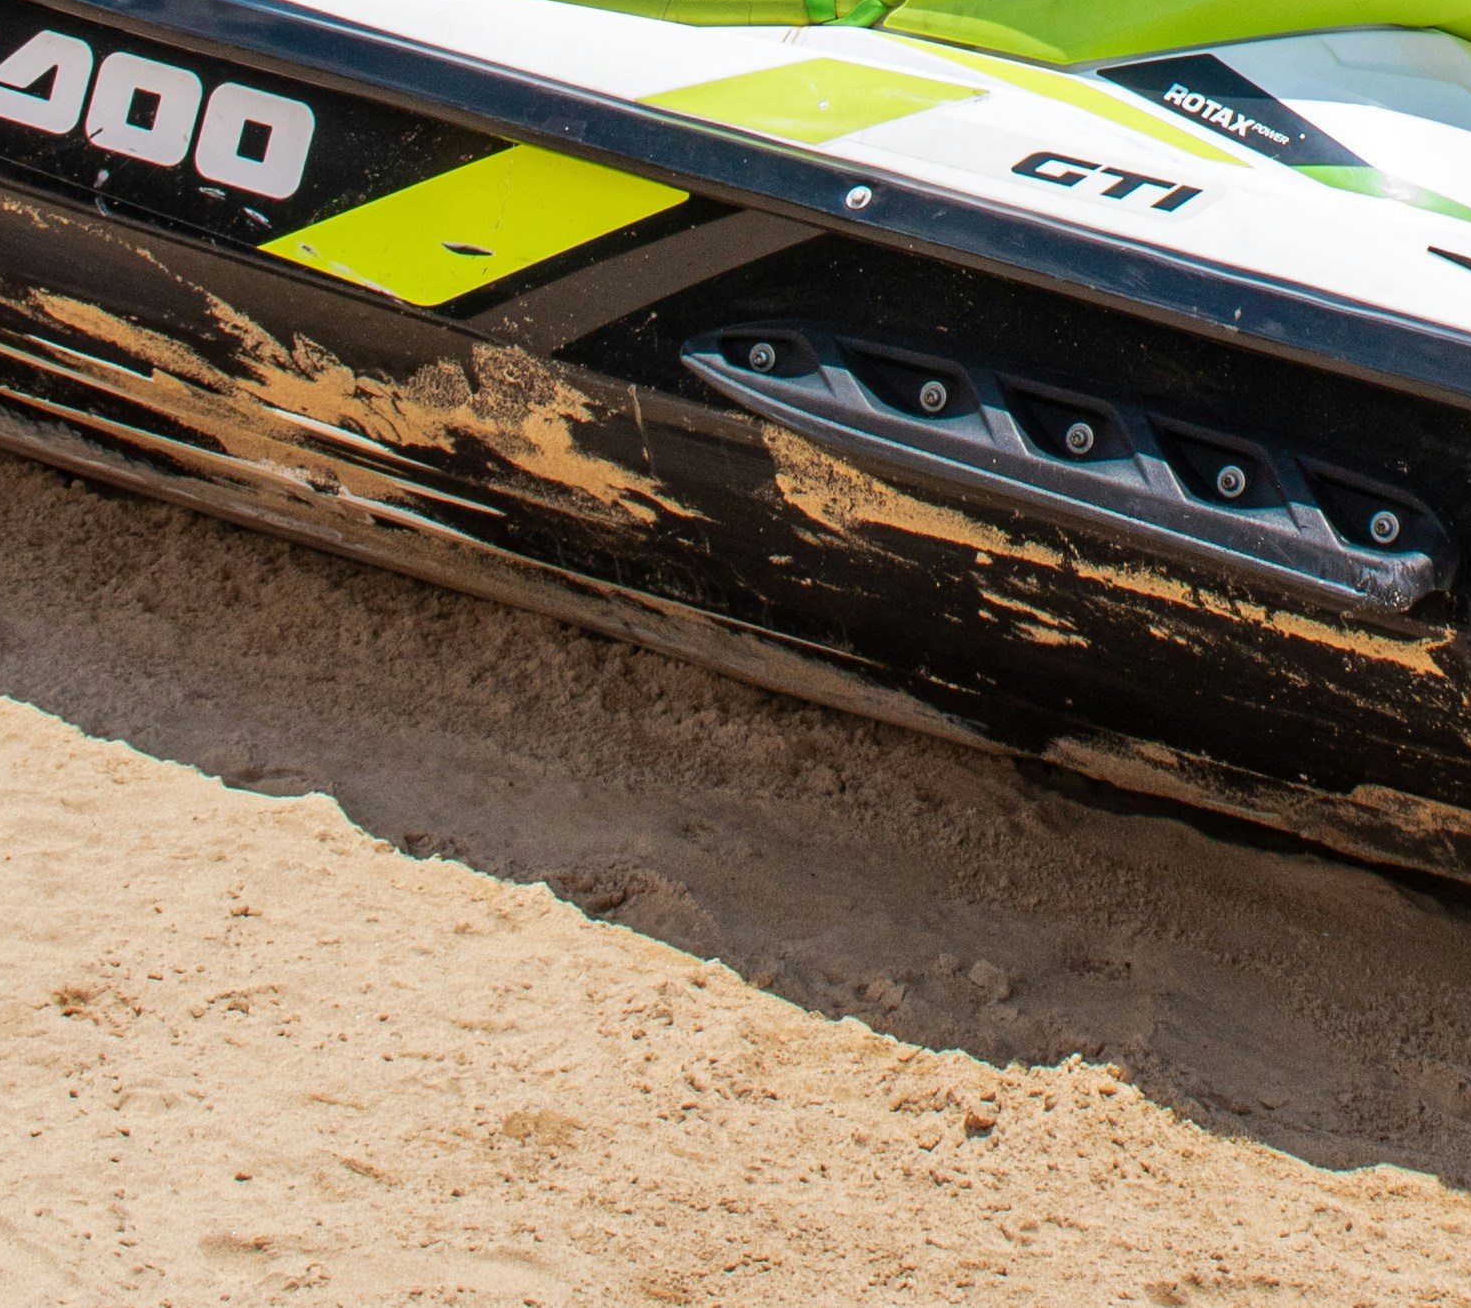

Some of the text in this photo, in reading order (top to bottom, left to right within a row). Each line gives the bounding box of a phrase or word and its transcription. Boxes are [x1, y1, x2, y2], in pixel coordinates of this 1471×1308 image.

[1163, 83, 1290, 145] ROTAX POWER
[1011, 151, 1204, 213] GTI
